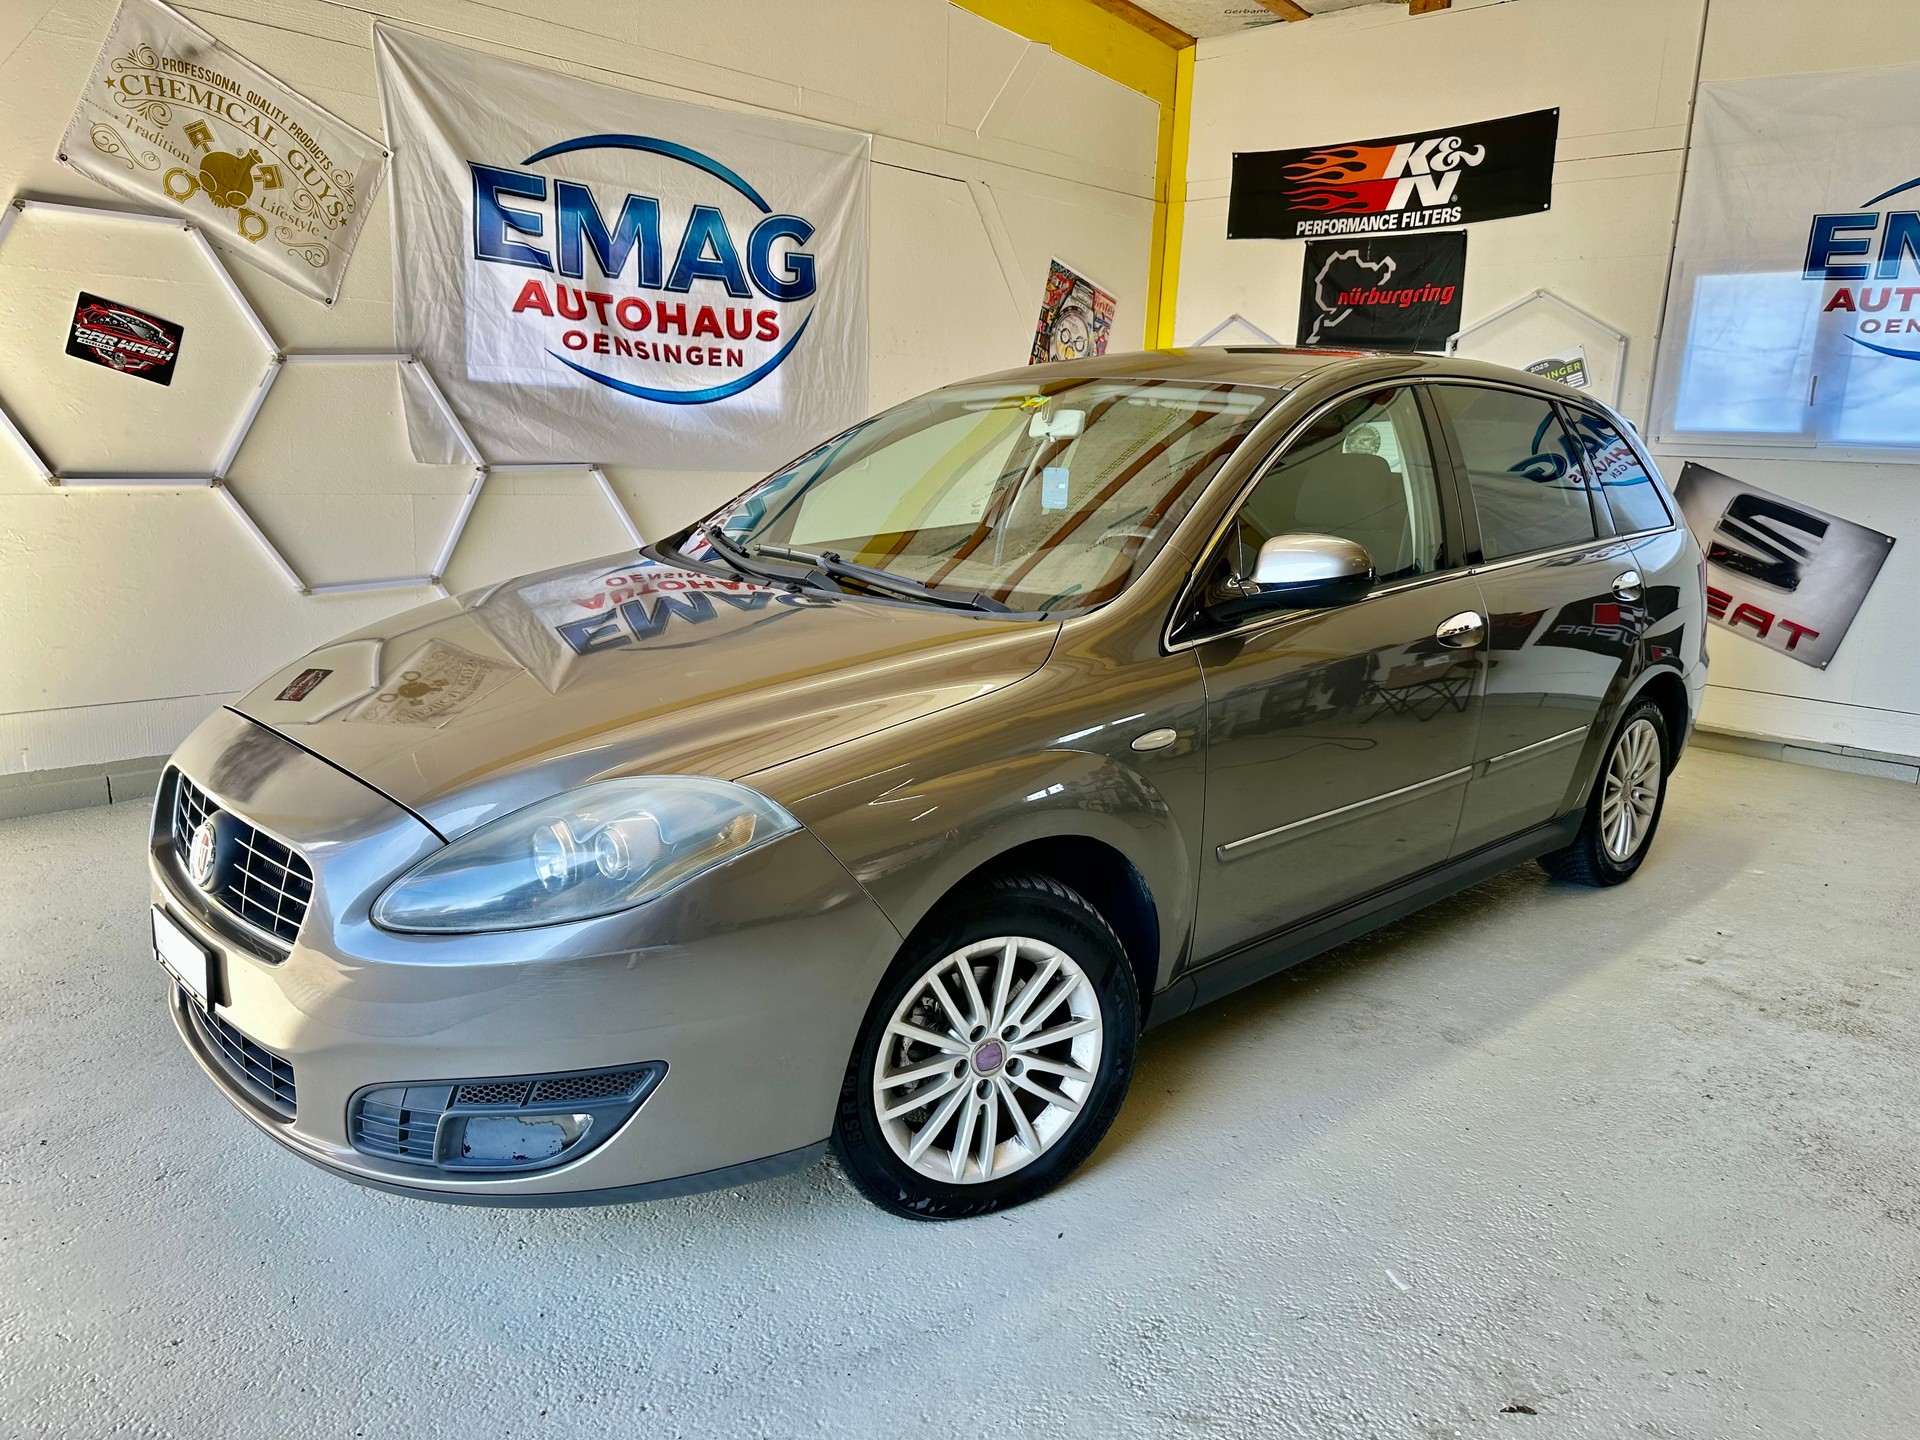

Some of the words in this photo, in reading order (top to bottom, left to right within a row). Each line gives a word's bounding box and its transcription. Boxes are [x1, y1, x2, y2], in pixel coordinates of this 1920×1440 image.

[161, 57, 242, 97] PROFESSIONAL
[246, 90, 289, 125] QUALITY
[288, 121, 334, 171] PRODUCTS
[119, 73, 278, 148] CHEMICAL
[287, 149, 345, 218] GUYS
[124, 113, 191, 164] Tradition
[260, 196, 320, 237] Lifestyle
[466, 159, 817, 302] EMAG
[1296, 213, 1399, 236] PERFORMANCE
[1401, 206, 1462, 228] FILTERS
[511, 279, 780, 343] AUTOHAUS
[1337, 283, 1456, 308] nürburgring
[74, 328, 118, 346] CAR
[116, 339, 174, 361] WASH
[562, 329, 744, 368] OENSINGEN
[1530, 362, 1549, 373] 2025
